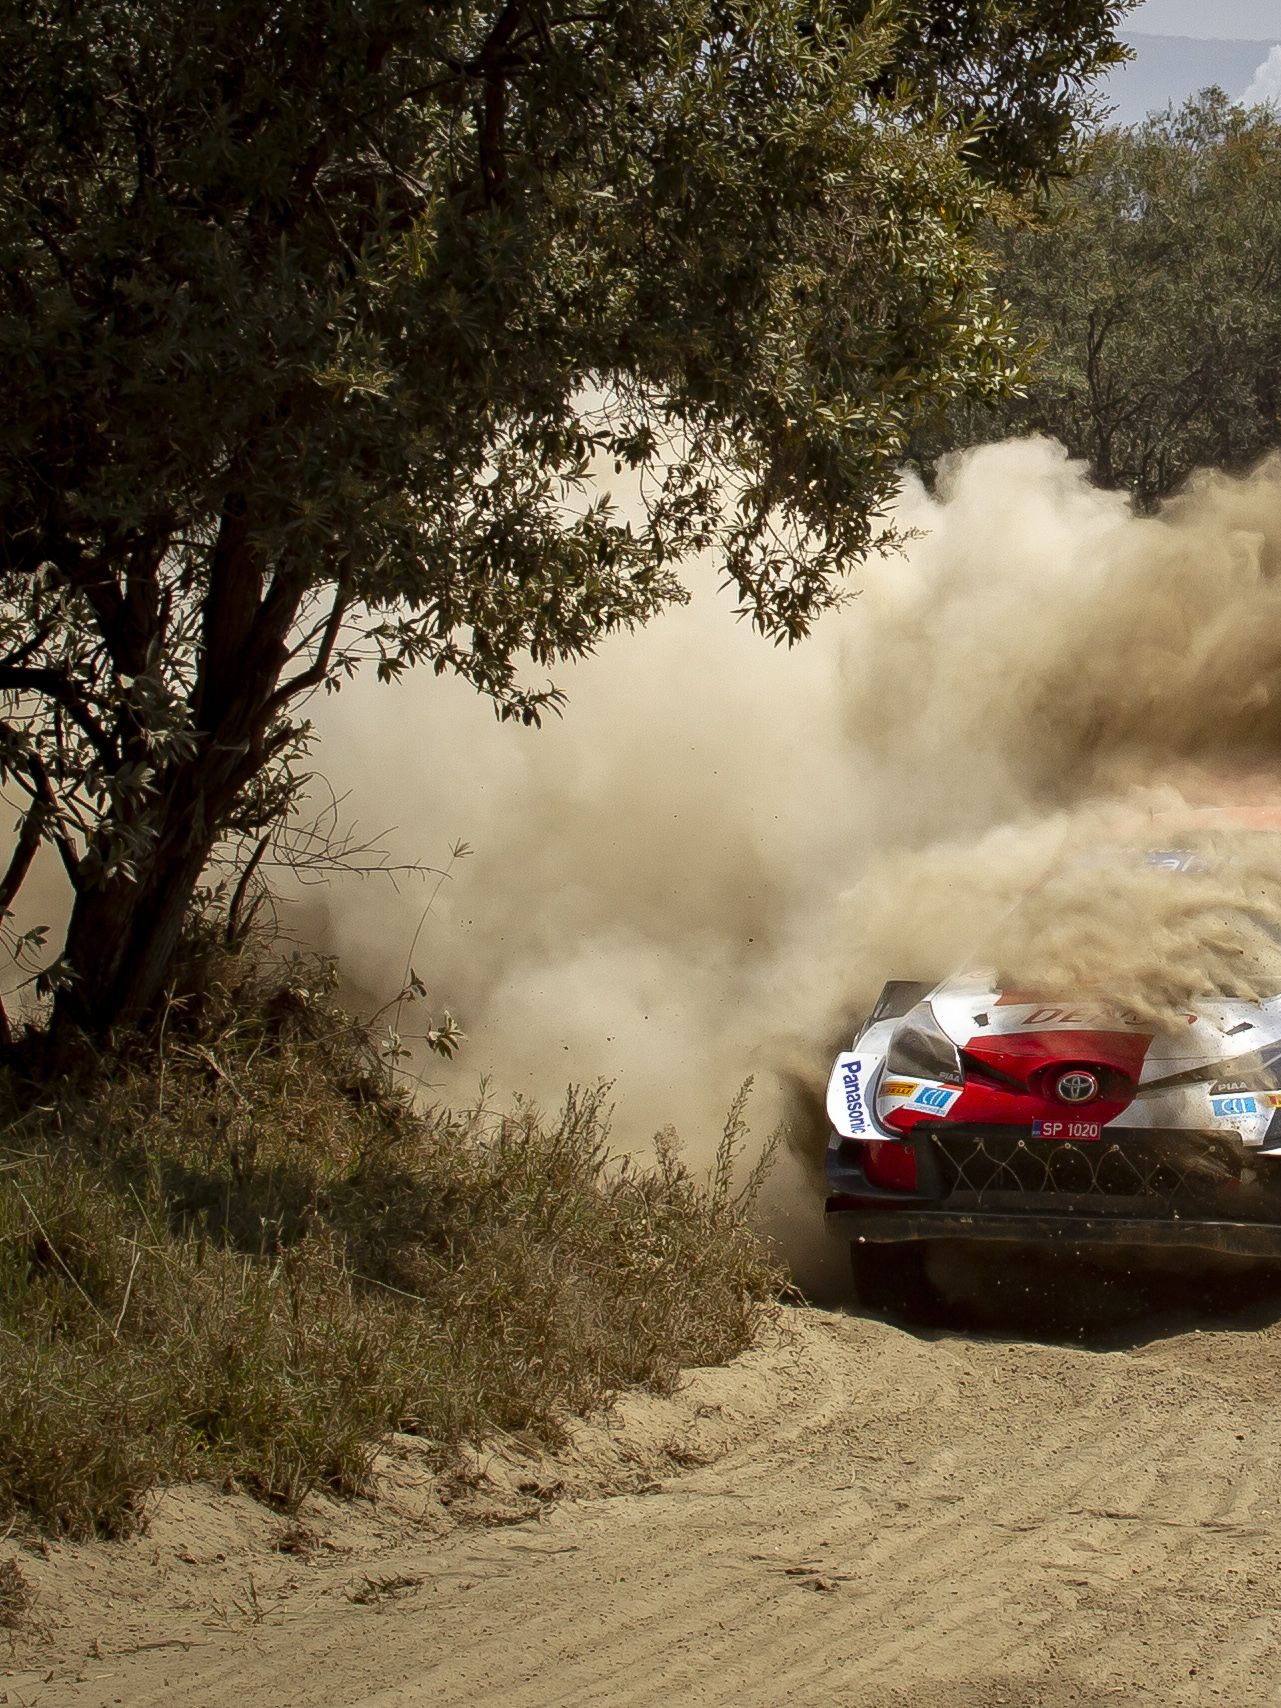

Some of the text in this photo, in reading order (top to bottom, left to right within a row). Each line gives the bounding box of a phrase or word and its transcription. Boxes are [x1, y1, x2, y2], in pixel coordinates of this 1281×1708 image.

[1218, 1082, 1248, 1091] PIAA
[841, 1060, 866, 1134] Panasonic
[1043, 1123, 1098, 1137] SP 1020
